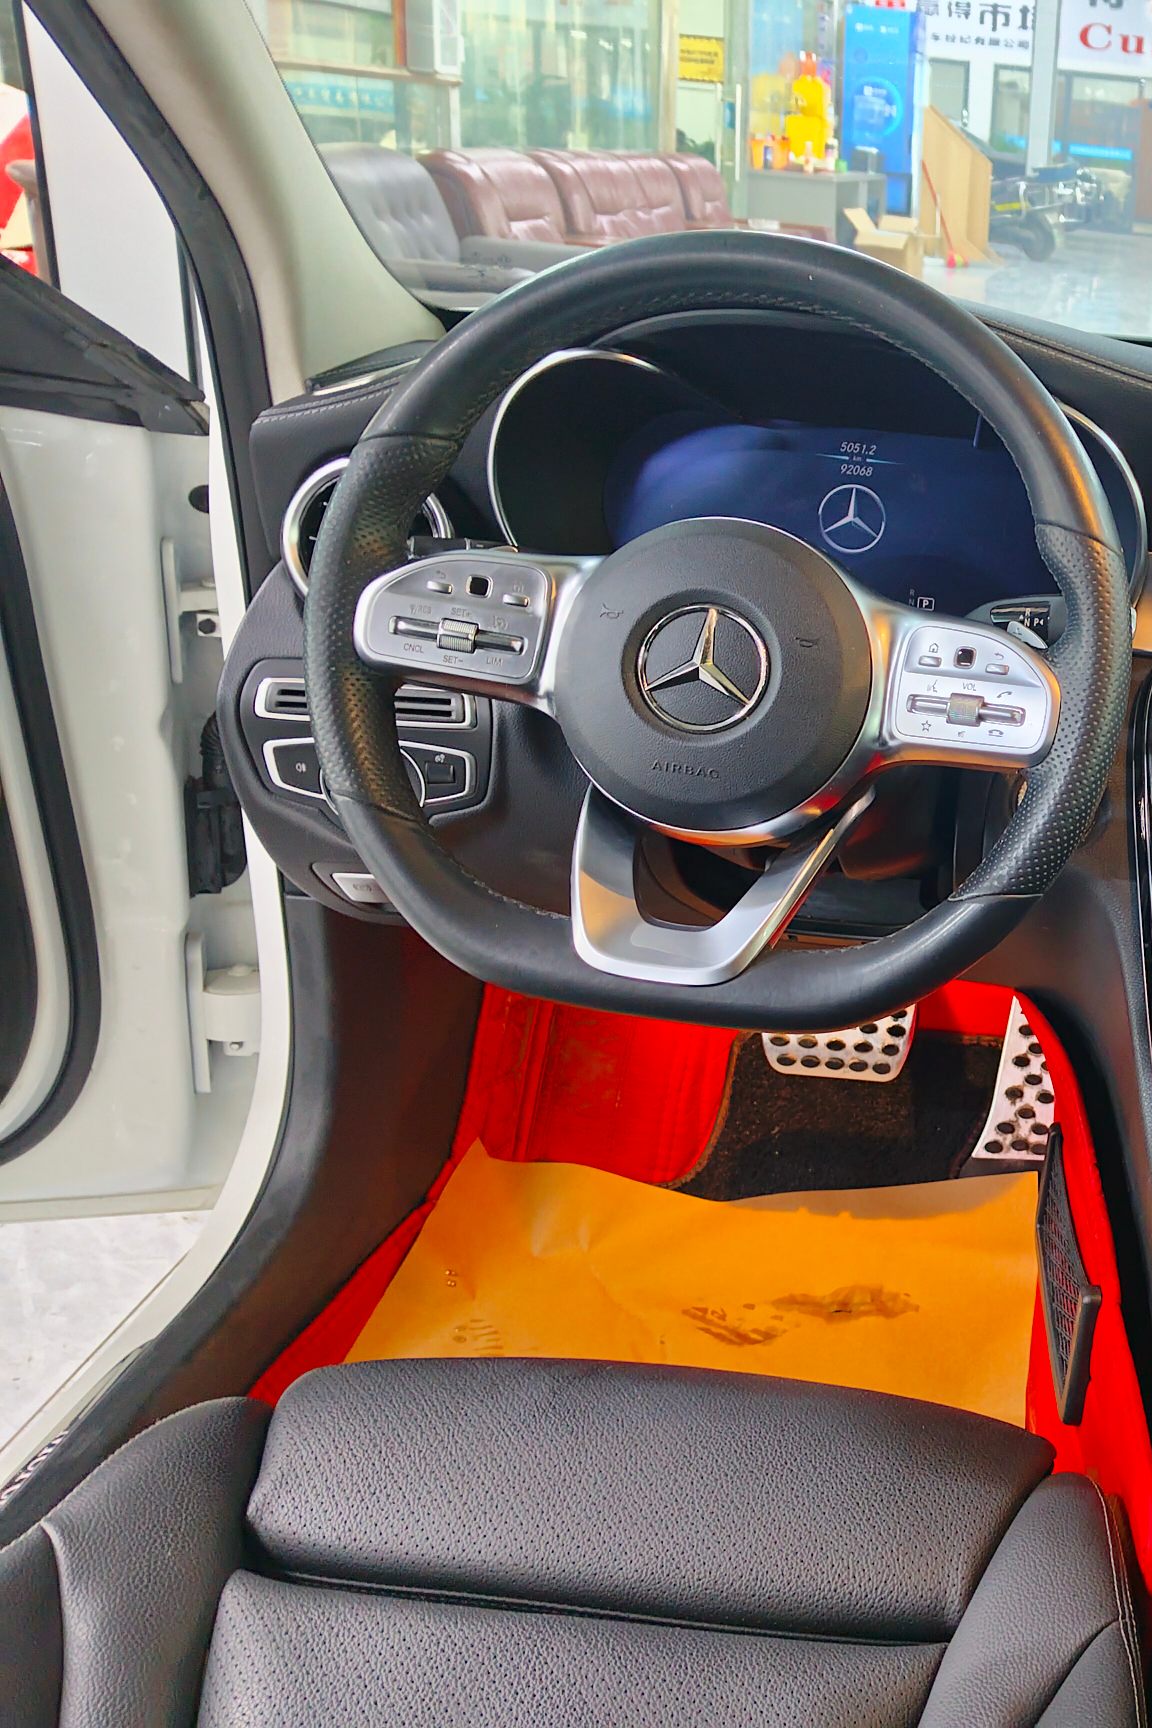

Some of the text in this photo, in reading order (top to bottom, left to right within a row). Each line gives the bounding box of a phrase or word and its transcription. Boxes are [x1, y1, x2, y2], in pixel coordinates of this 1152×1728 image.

[840, 441, 877, 456] 5051.2
[840, 464, 873, 477] 92068
[922, 599, 930, 608] P
[403, 643, 424, 654] CNCL
[962, 682, 977, 692] VOL
[652, 761, 720, 780] AIRBAG
